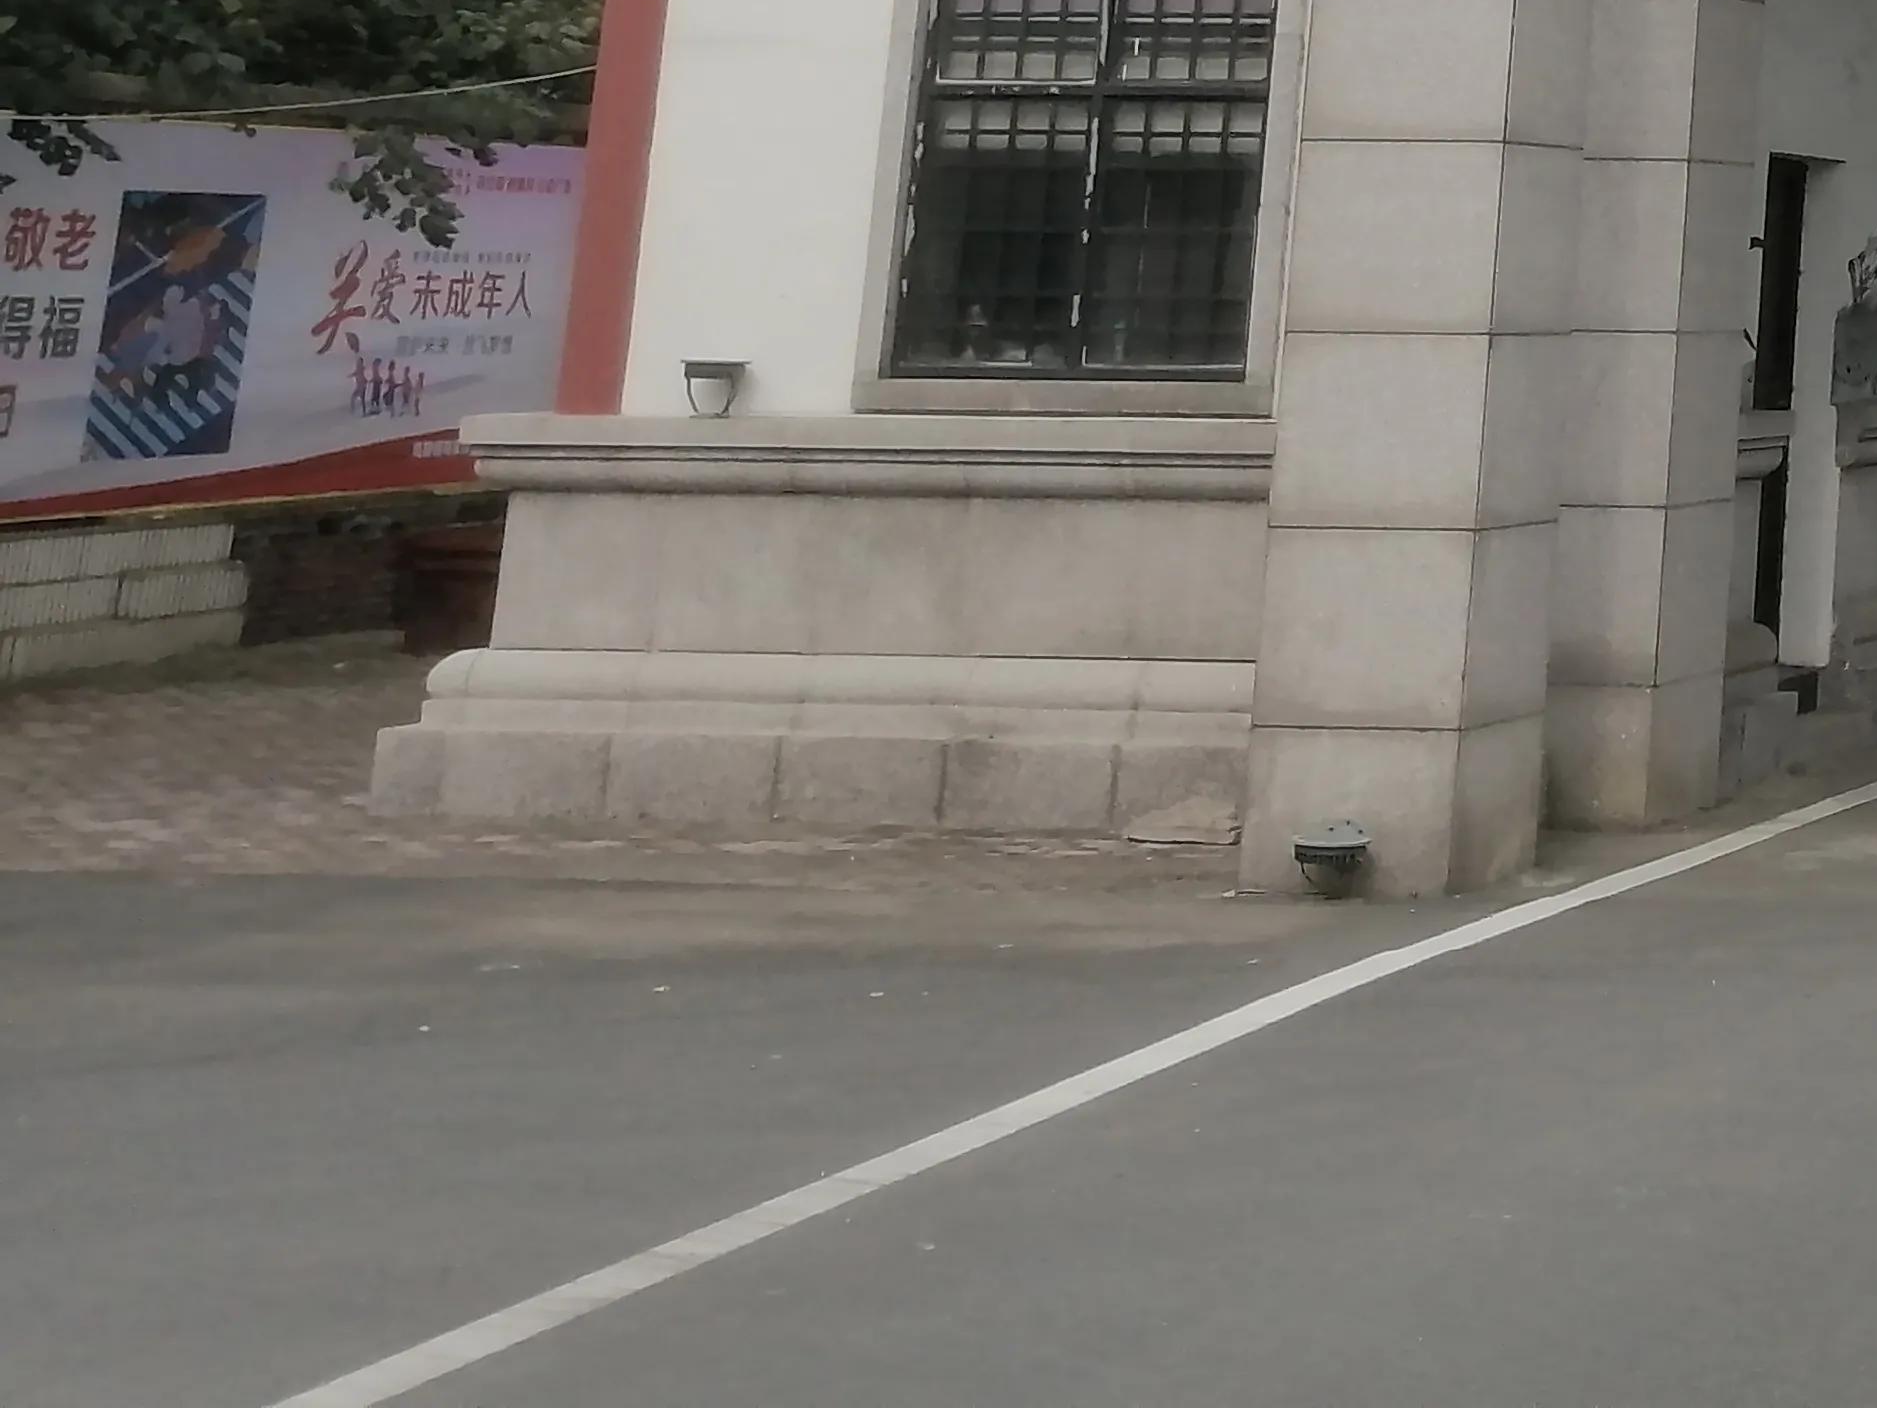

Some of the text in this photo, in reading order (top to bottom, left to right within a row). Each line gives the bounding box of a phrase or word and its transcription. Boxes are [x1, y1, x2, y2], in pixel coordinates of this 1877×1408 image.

[311, 239, 532, 355] 关爱未成年人
